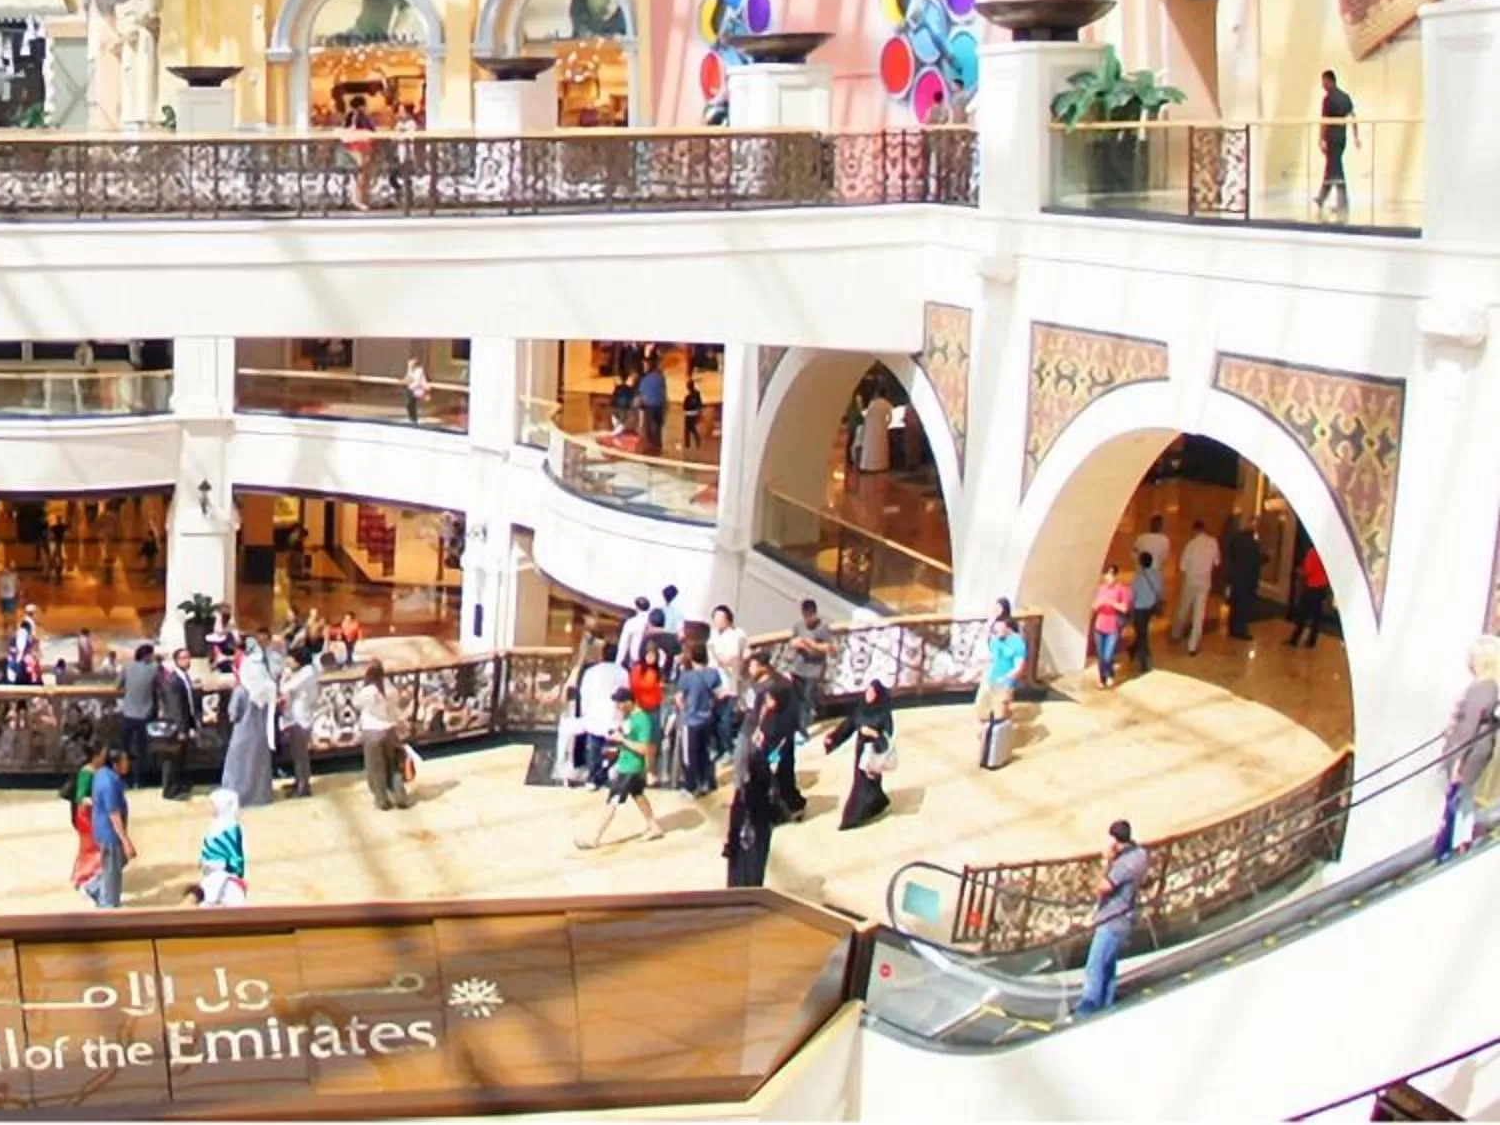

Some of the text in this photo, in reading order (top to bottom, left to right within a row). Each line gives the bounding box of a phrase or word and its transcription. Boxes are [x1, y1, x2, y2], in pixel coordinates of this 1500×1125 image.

[25, 1036, 71, 1071] of
[82, 1034, 155, 1070] the
[167, 1015, 437, 1067] Emirates
